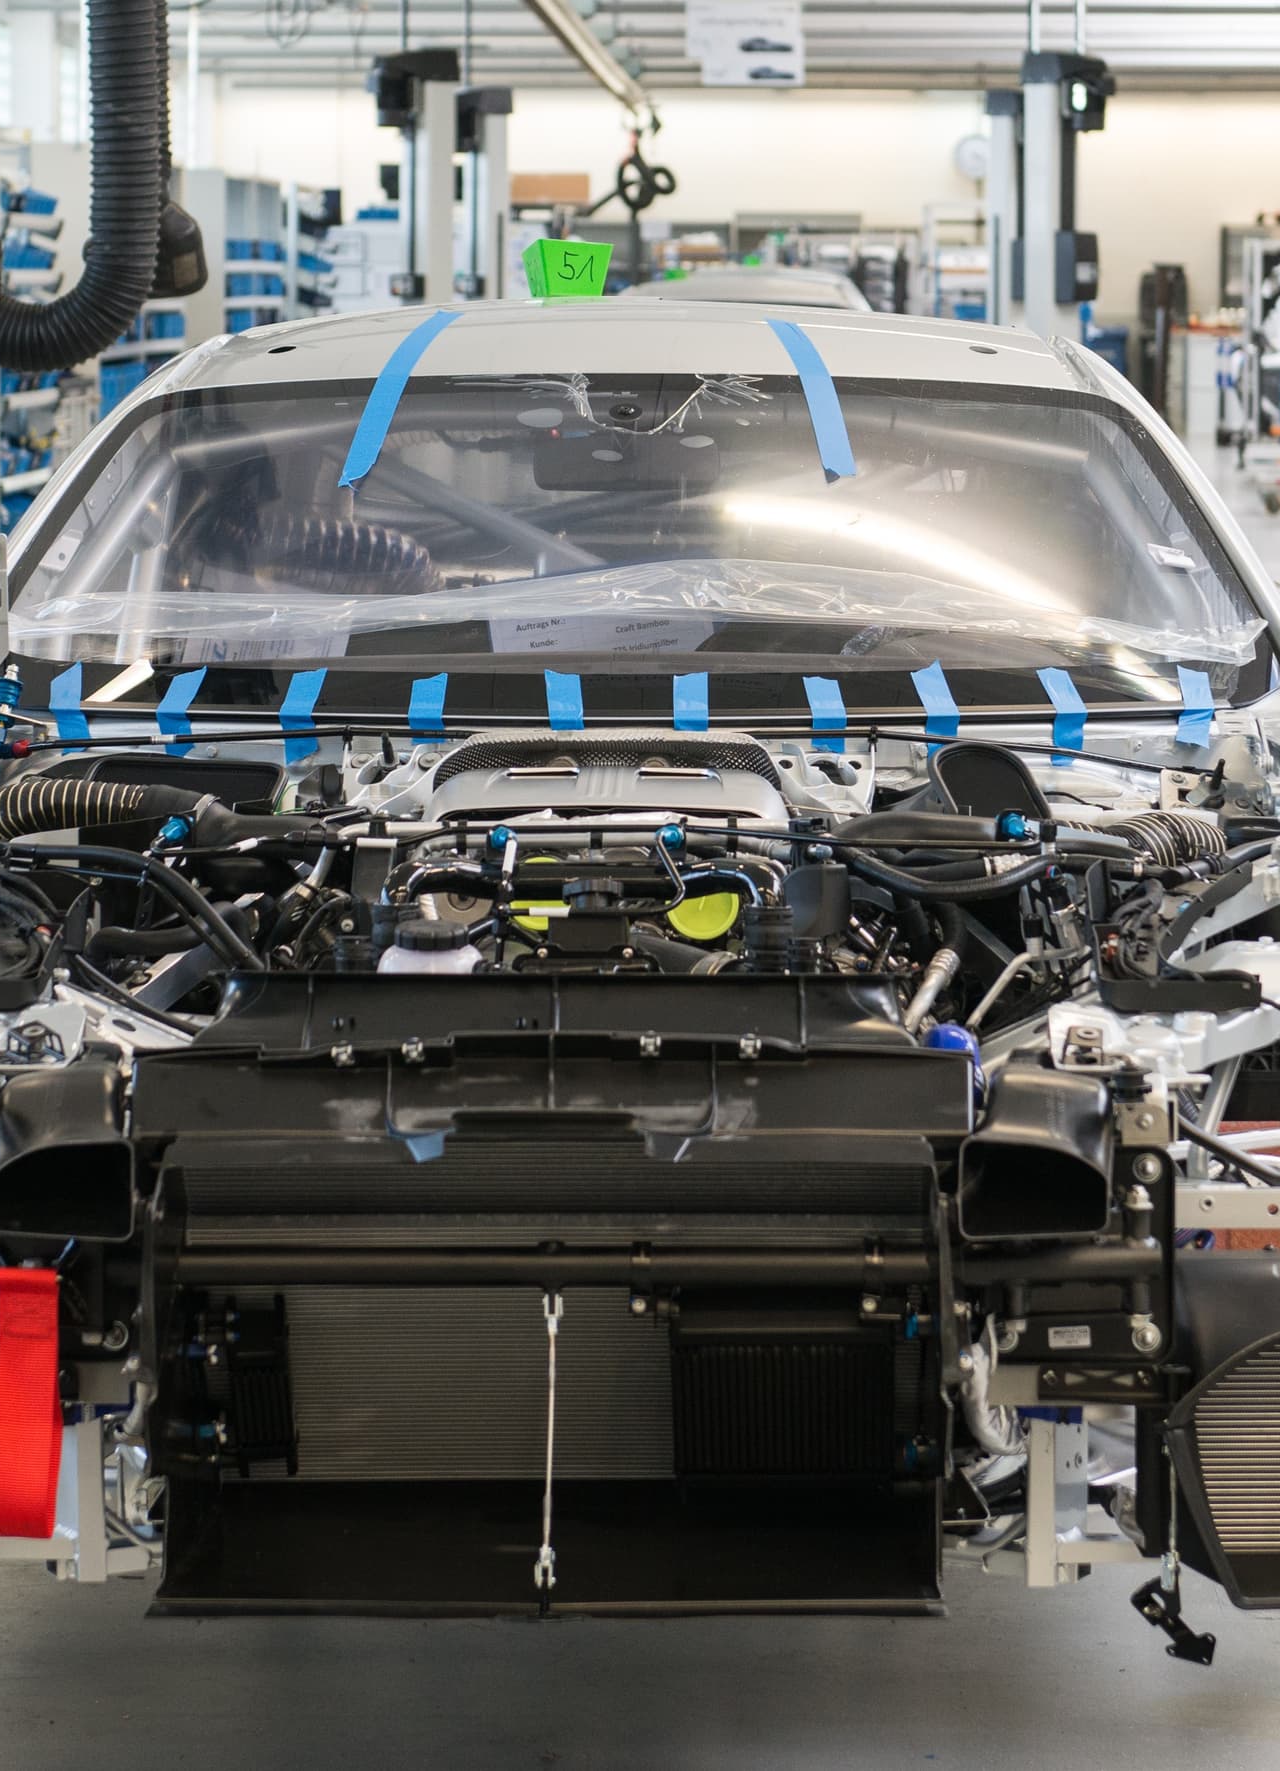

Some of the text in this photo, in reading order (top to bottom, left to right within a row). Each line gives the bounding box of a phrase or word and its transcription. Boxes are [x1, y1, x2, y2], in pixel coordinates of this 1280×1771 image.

[557, 251, 595, 283] 51
[516, 622, 549, 632] Auftrags
[615, 623, 635, 633] Craft
